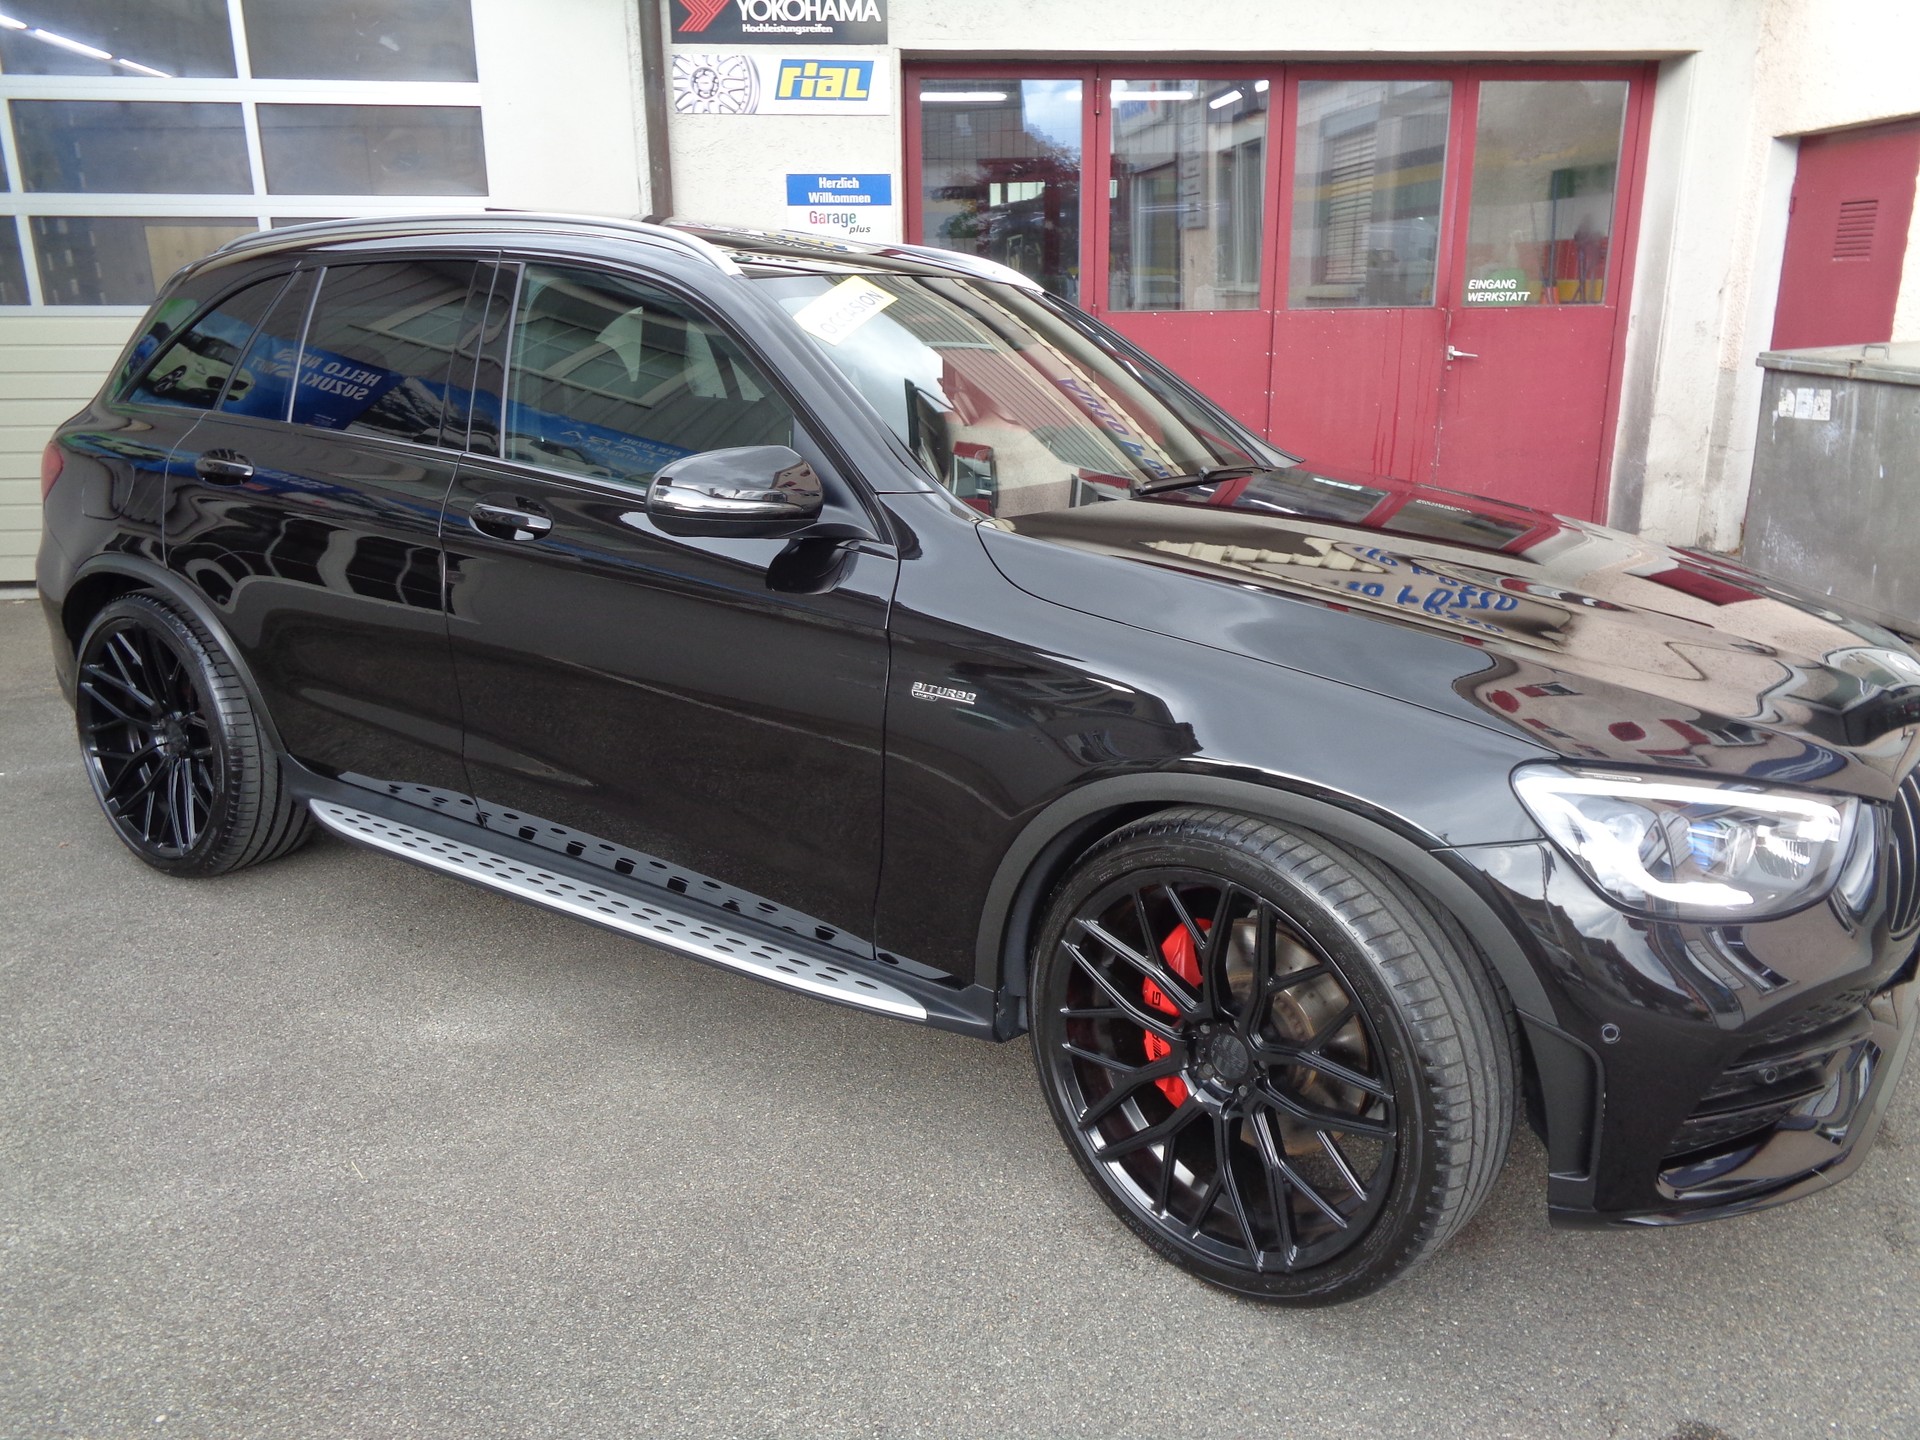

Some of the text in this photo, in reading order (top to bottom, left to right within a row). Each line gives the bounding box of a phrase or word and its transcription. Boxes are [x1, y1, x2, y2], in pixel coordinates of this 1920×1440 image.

[737, 0, 882, 22] YOKOHAMA
[742, 23, 834, 35] Hochleistungsreifen
[818, 177, 860, 189] Herzlich
[808, 192, 872, 203] Willkommen
[809, 211, 857, 228] Garage
[849, 225, 871, 234] plus
[1467, 279, 1517, 290] EINGANG
[1467, 291, 1531, 302] WERKSTATT
[820, 289, 884, 334] OCCASION
[911, 681, 977, 701] BITURBO
